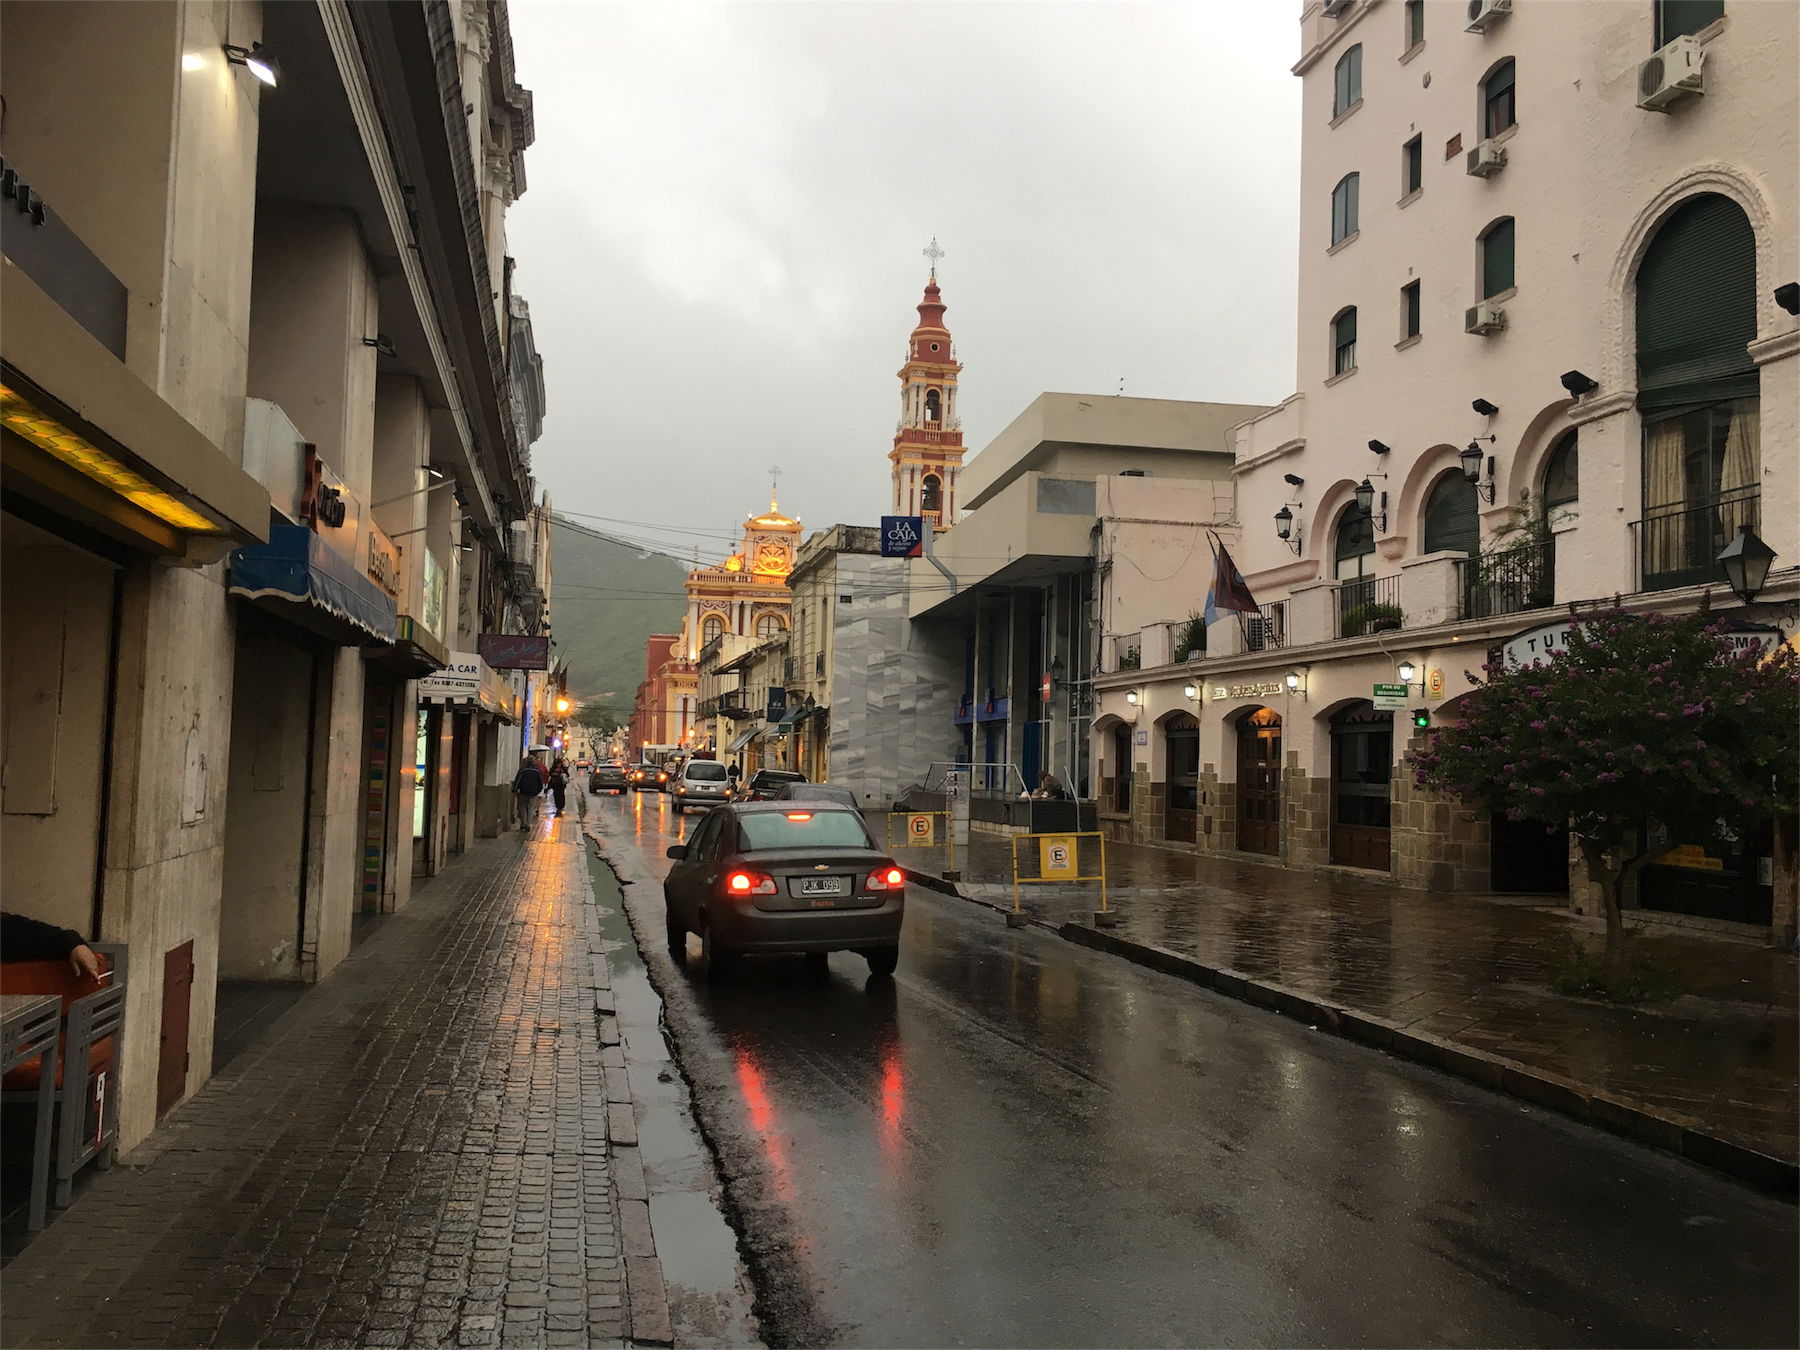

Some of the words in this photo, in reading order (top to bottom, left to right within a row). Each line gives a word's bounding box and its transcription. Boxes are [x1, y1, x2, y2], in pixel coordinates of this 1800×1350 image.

[895, 521, 912, 531] LA
[887, 529, 918, 543] CAJA
[447, 663, 455, 672] A
[457, 664, 477, 674] CAR
[1433, 674, 1439, 687] E
[915, 820, 926, 833] E
[1054, 849, 1064, 861] E
[803, 881, 819, 890] PJK
[823, 880, 839, 889] 099
